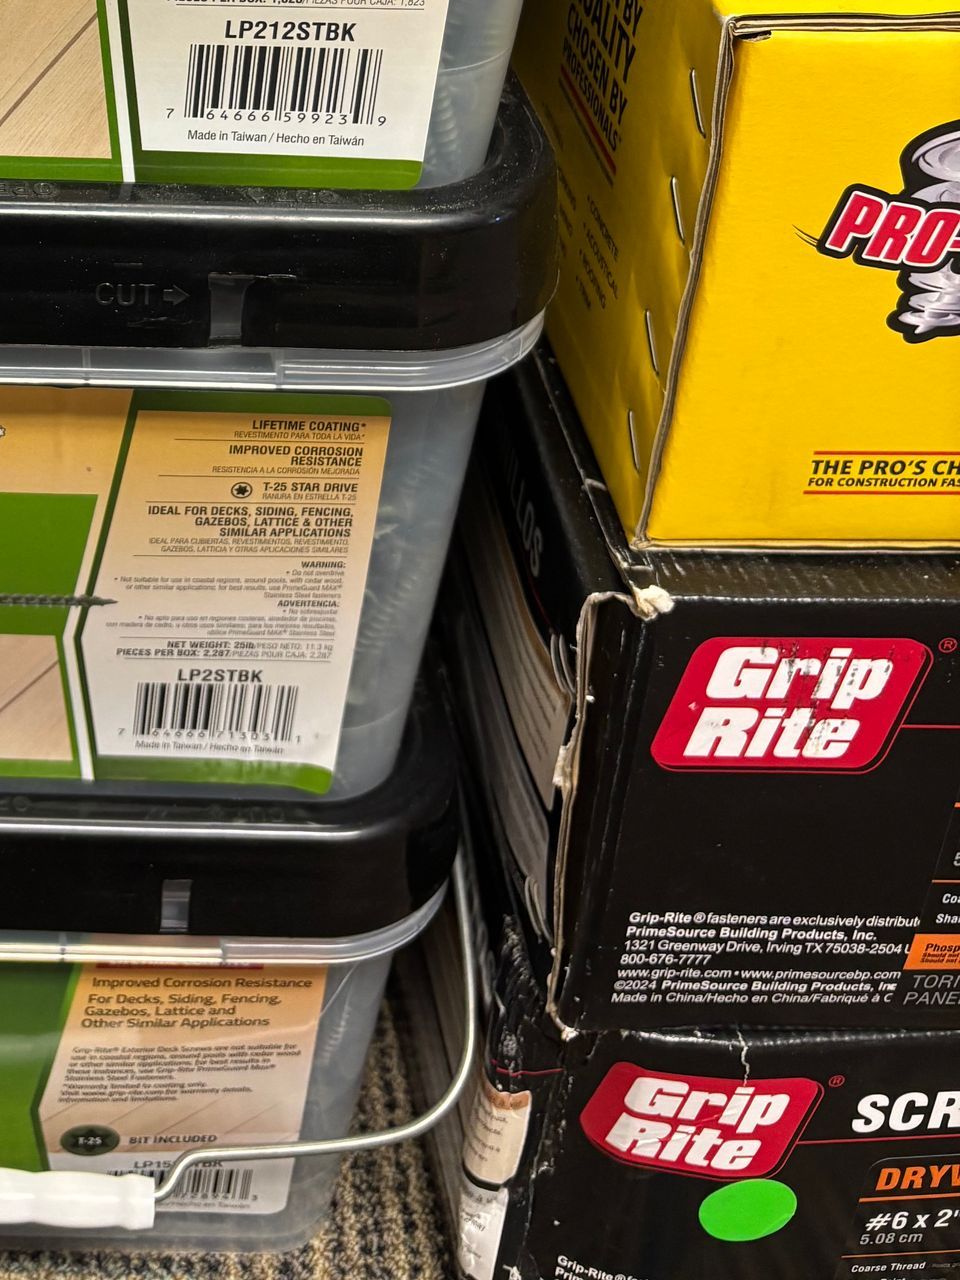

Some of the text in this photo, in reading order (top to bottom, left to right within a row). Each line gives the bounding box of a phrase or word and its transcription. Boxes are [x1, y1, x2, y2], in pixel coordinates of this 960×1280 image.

[225, 21, 357, 42] LP212STBK
[567, 2, 628, 124] CHOSEN BY
[562, 38, 618, 152] PROFESSIONALS
[188, 129, 216, 140] Made
[220, 129, 229, 141] in
[231, 130, 267, 142] Taiwan
[276, 132, 310, 143] Hecho
[313, 135, 326, 143] en
[328, 134, 364, 146] Taiwán
[95, 281, 156, 308] CUT
[811, 460, 854, 475] THE
[178, 669, 263, 682] LP2STBK
[706, 647, 894, 710] Grip
[683, 707, 862, 758] Rite
[626, 926, 877, 942] PrimeSource Building Products, Inc.
[620, 953, 712, 966] 800-676-7777
[93, 977, 312, 990] Improved Corrosion Resistance
[624, 1077, 791, 1133] Grip
[605, 1112, 763, 1171] Rite
[851, 1261, 926, 1273] Coarse Thread
